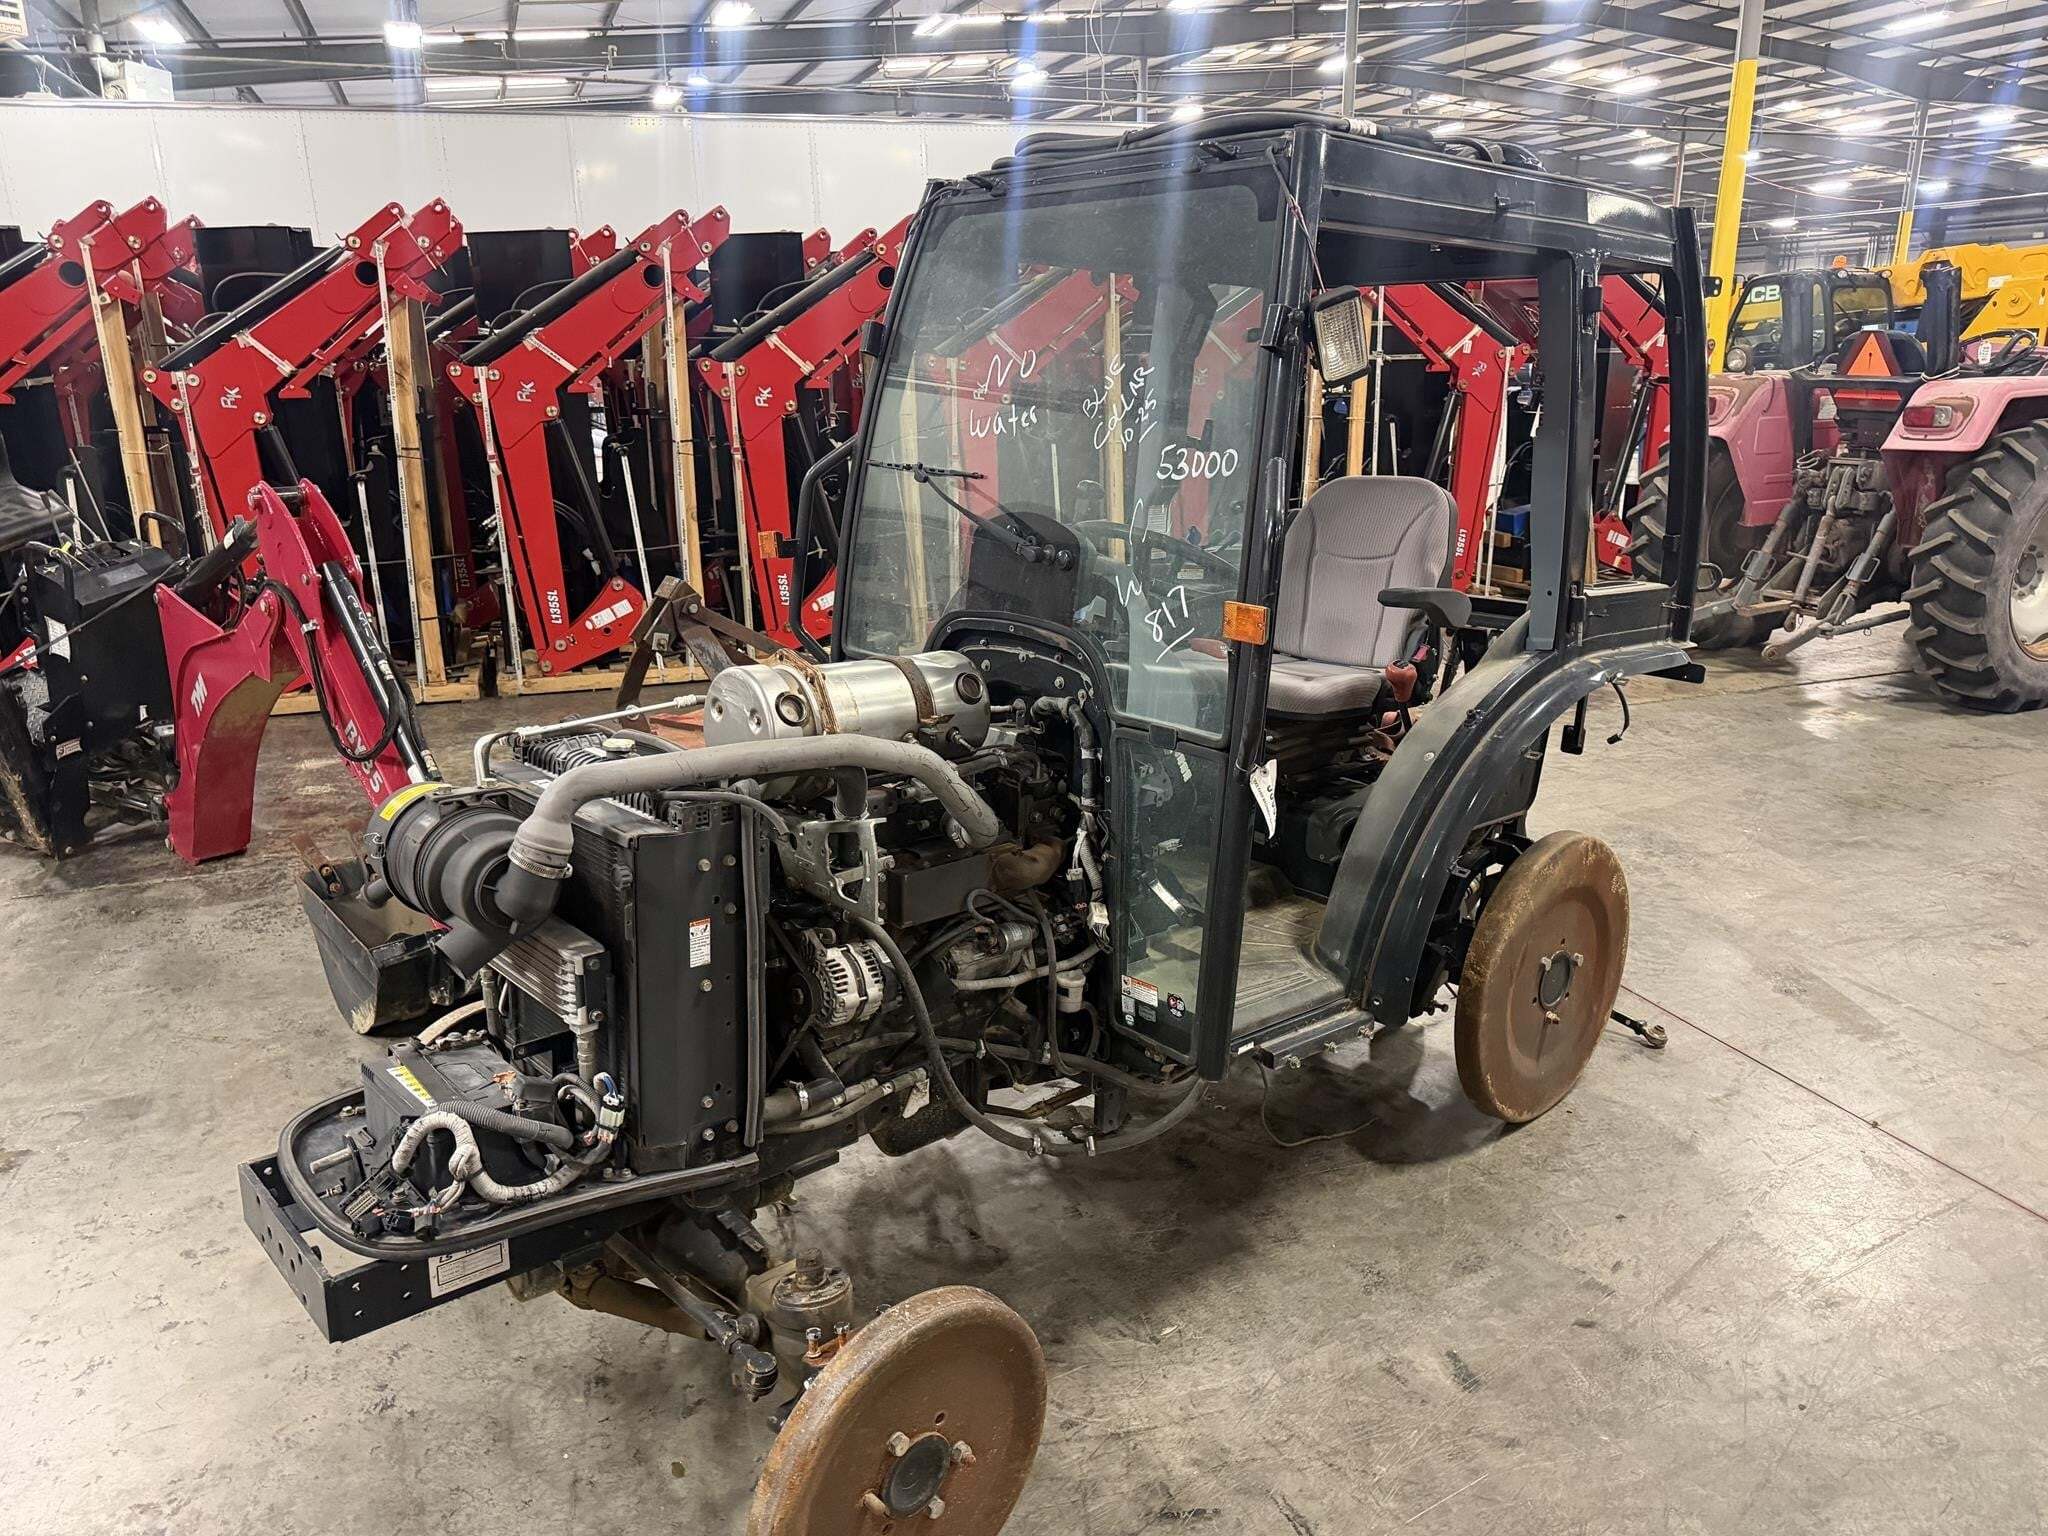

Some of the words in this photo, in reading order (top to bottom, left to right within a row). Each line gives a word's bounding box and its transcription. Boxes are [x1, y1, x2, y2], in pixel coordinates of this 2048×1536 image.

[985, 349, 1036, 394] NO
[1082, 353, 1126, 420] BLUE
[220, 386, 242, 409] RK
[516, 381, 537, 403] RK
[755, 386, 774, 408] RK
[1156, 443, 1239, 481] 53000
[547, 589, 563, 624] L135SL
[777, 573, 790, 606] L135SL
[1144, 585, 1189, 642] 817
